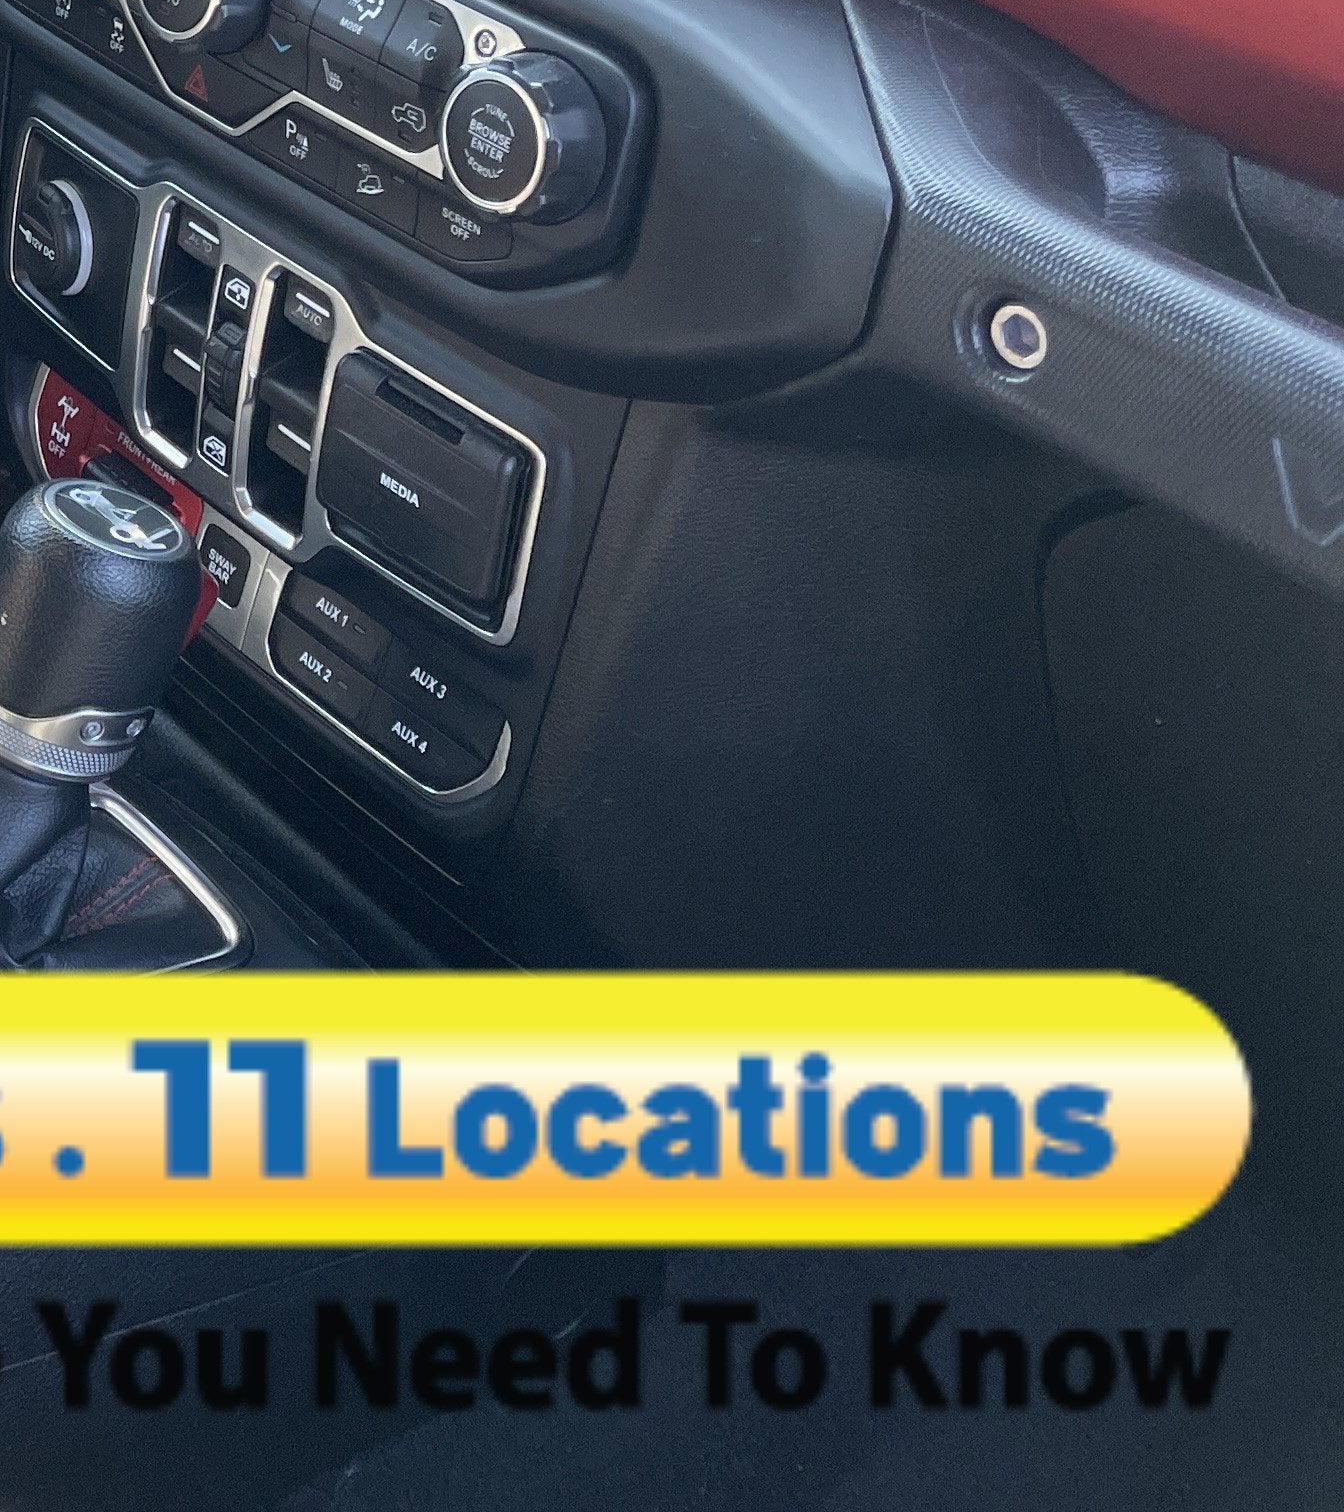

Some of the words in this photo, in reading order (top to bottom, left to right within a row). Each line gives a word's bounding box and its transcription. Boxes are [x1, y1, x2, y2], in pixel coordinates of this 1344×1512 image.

[55, 6, 70, 20] OFF
[339, 16, 364, 36] MODE
[406, 37, 437, 62] A/C
[485, 103, 509, 123] TUNE
[286, 119, 297, 138] P
[469, 117, 513, 150] BROWSE
[289, 145, 308, 161] OFF
[470, 136, 504, 163] ENTER
[467, 155, 500, 179] SCROLL
[441, 206, 482, 236] SCREEN
[450, 224, 471, 241] OFF
[43, 245, 56, 261] DC
[296, 303, 323, 326] AUTO
[48, 440, 66, 458] OFF
[380, 471, 420, 509] MEDIA
[207, 547, 237, 576] SWAY
[208, 563, 230, 585] BAR
[315, 596, 341, 622] AUX
[341, 615, 349, 628] 1
[299, 650, 324, 677] AUX
[323, 668, 333, 683] 2
[410, 665, 438, 692] AUX
[437, 684, 448, 700] 3
[391, 720, 418, 747] AUX
[417, 740, 428, 755] 4
